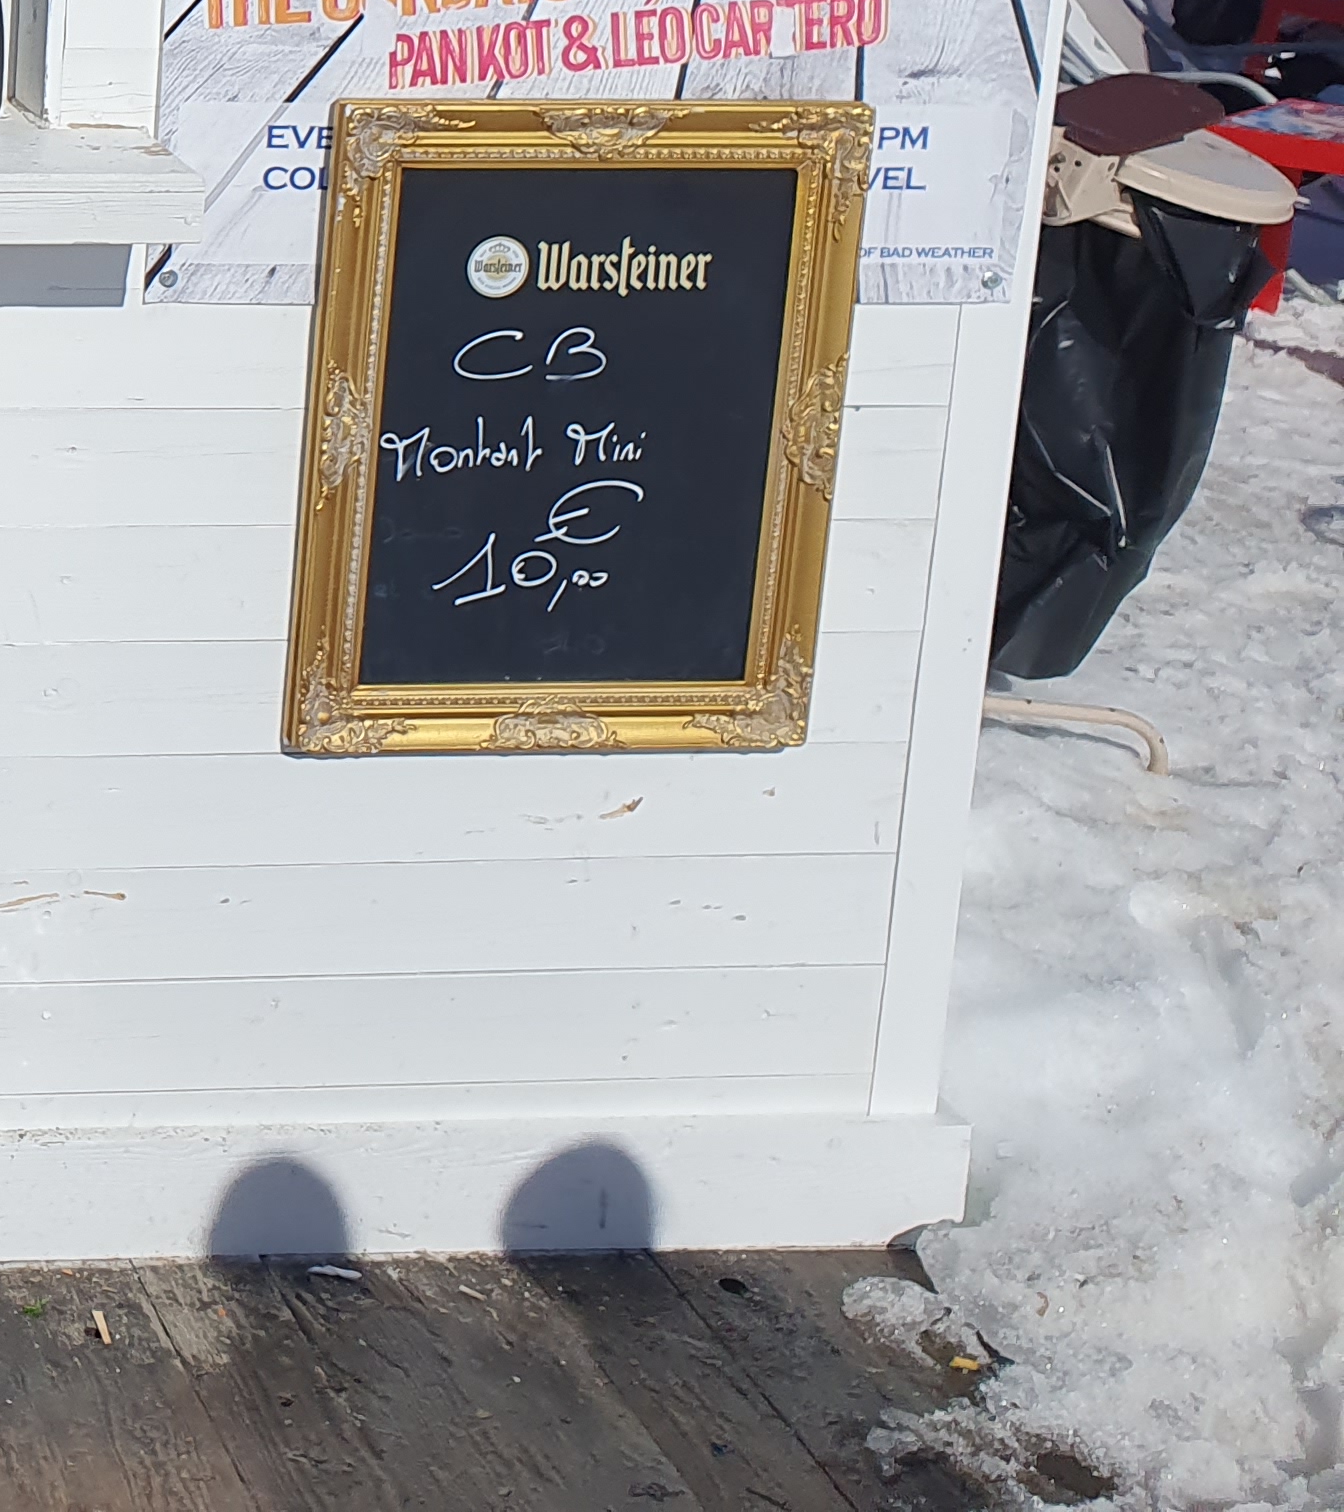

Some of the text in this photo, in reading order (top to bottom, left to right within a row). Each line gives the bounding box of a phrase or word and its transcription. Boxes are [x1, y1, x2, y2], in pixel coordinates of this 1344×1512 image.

[561, 13, 602, 73] &
[878, 126, 930, 151] PM
[537, 234, 714, 298] Warsteiner
[880, 247, 913, 258] BAD
[916, 247, 994, 259] WEATHER
[380, 416, 543, 482] Montant
